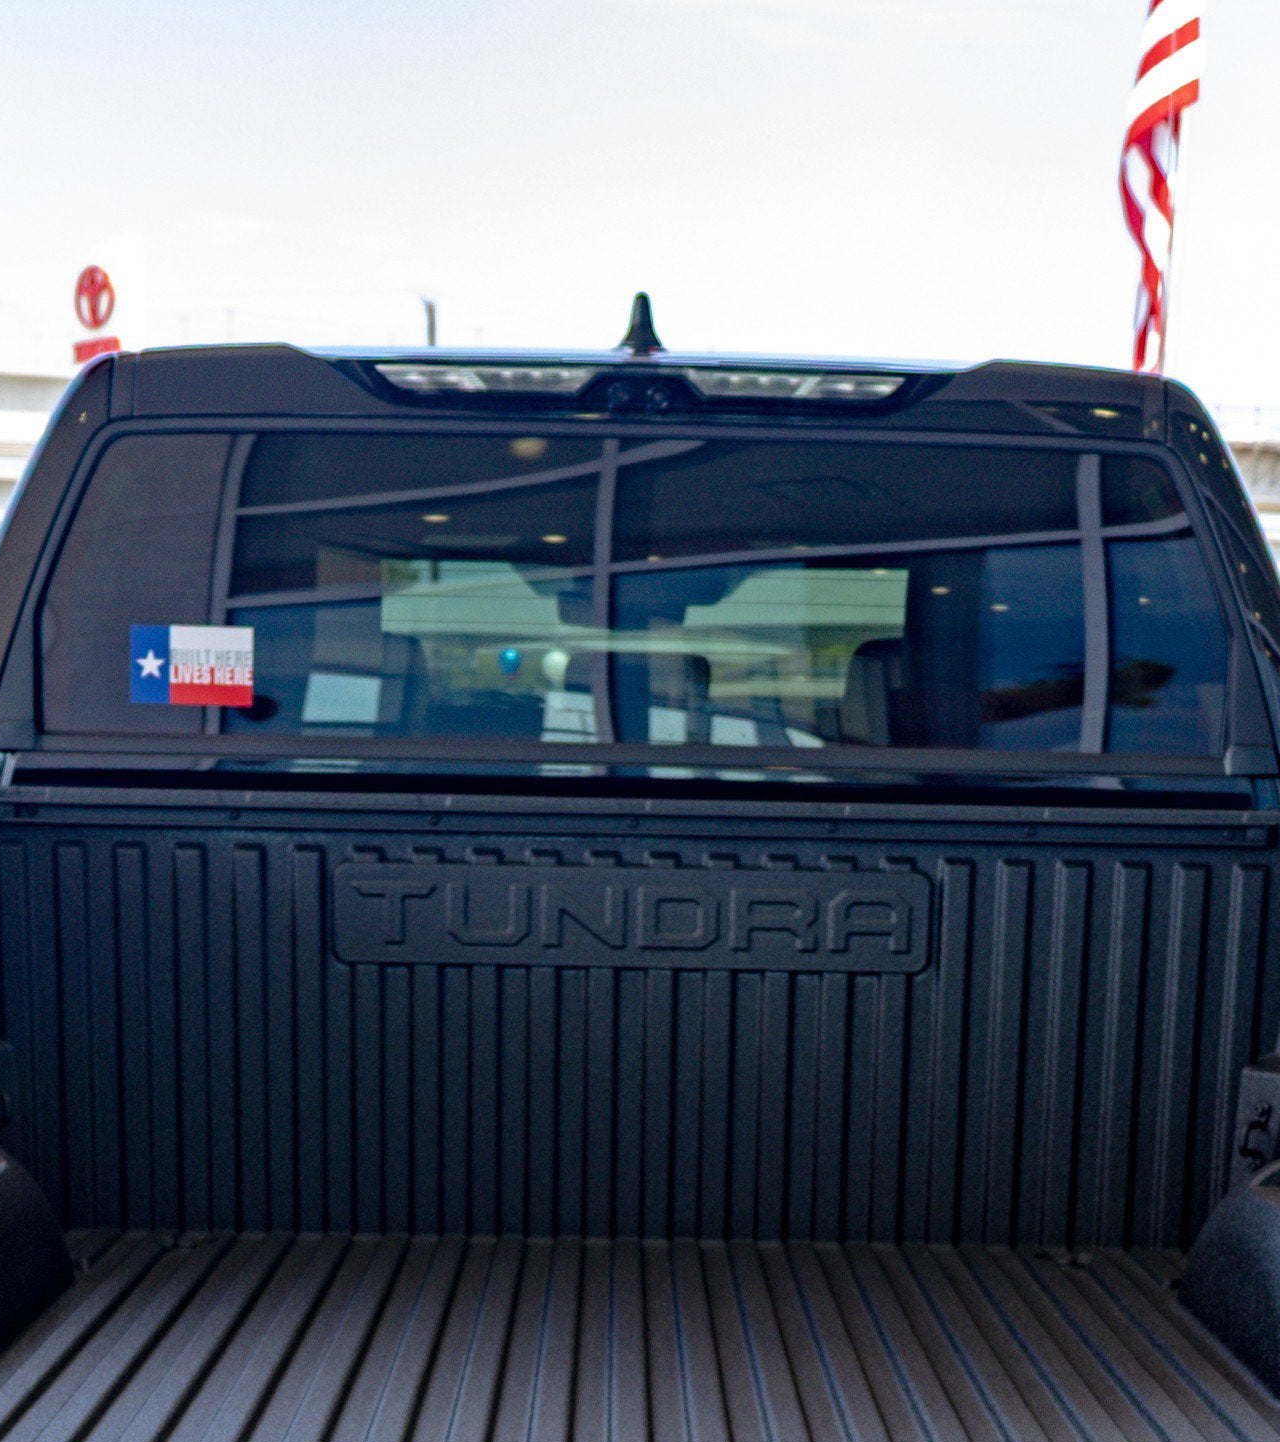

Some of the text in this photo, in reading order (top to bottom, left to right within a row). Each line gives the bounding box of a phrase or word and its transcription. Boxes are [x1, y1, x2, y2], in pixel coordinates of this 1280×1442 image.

[170, 648, 254, 667] BUILT HERE
[170, 665, 254, 686] LIVES HERE
[351, 880, 915, 955] TUNDRA
